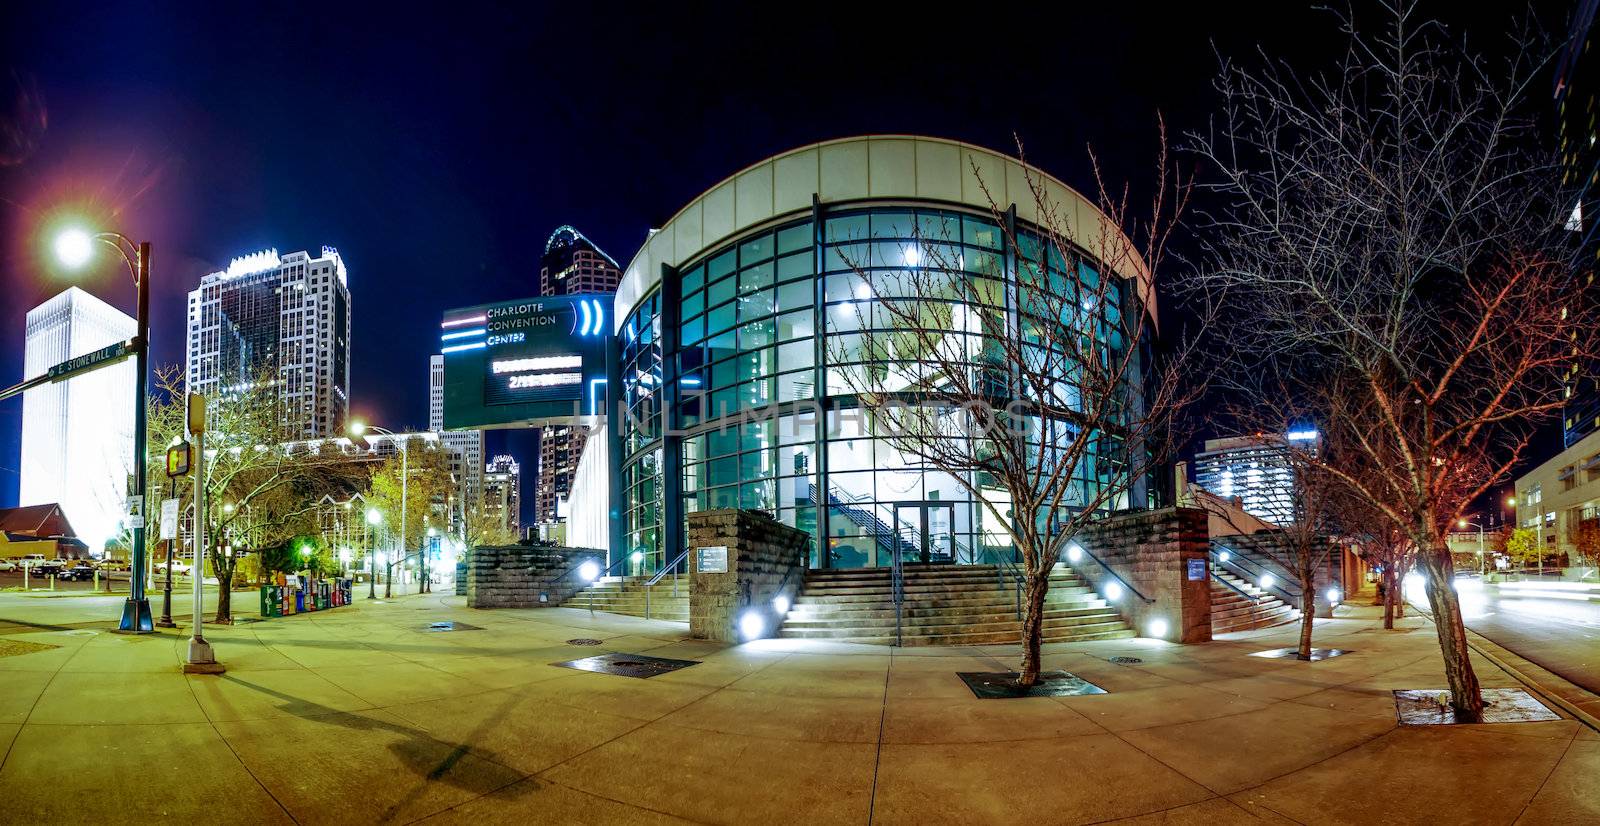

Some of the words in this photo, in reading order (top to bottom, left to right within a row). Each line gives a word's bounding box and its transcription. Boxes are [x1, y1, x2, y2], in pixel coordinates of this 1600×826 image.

[487, 303, 544, 318] CHARLOTTE
[487, 315, 556, 331] CONVENTION
[487, 333, 526, 346] CENTER
[58, 364, 64, 373] E
[67, 348, 110, 370] STONEWALL
